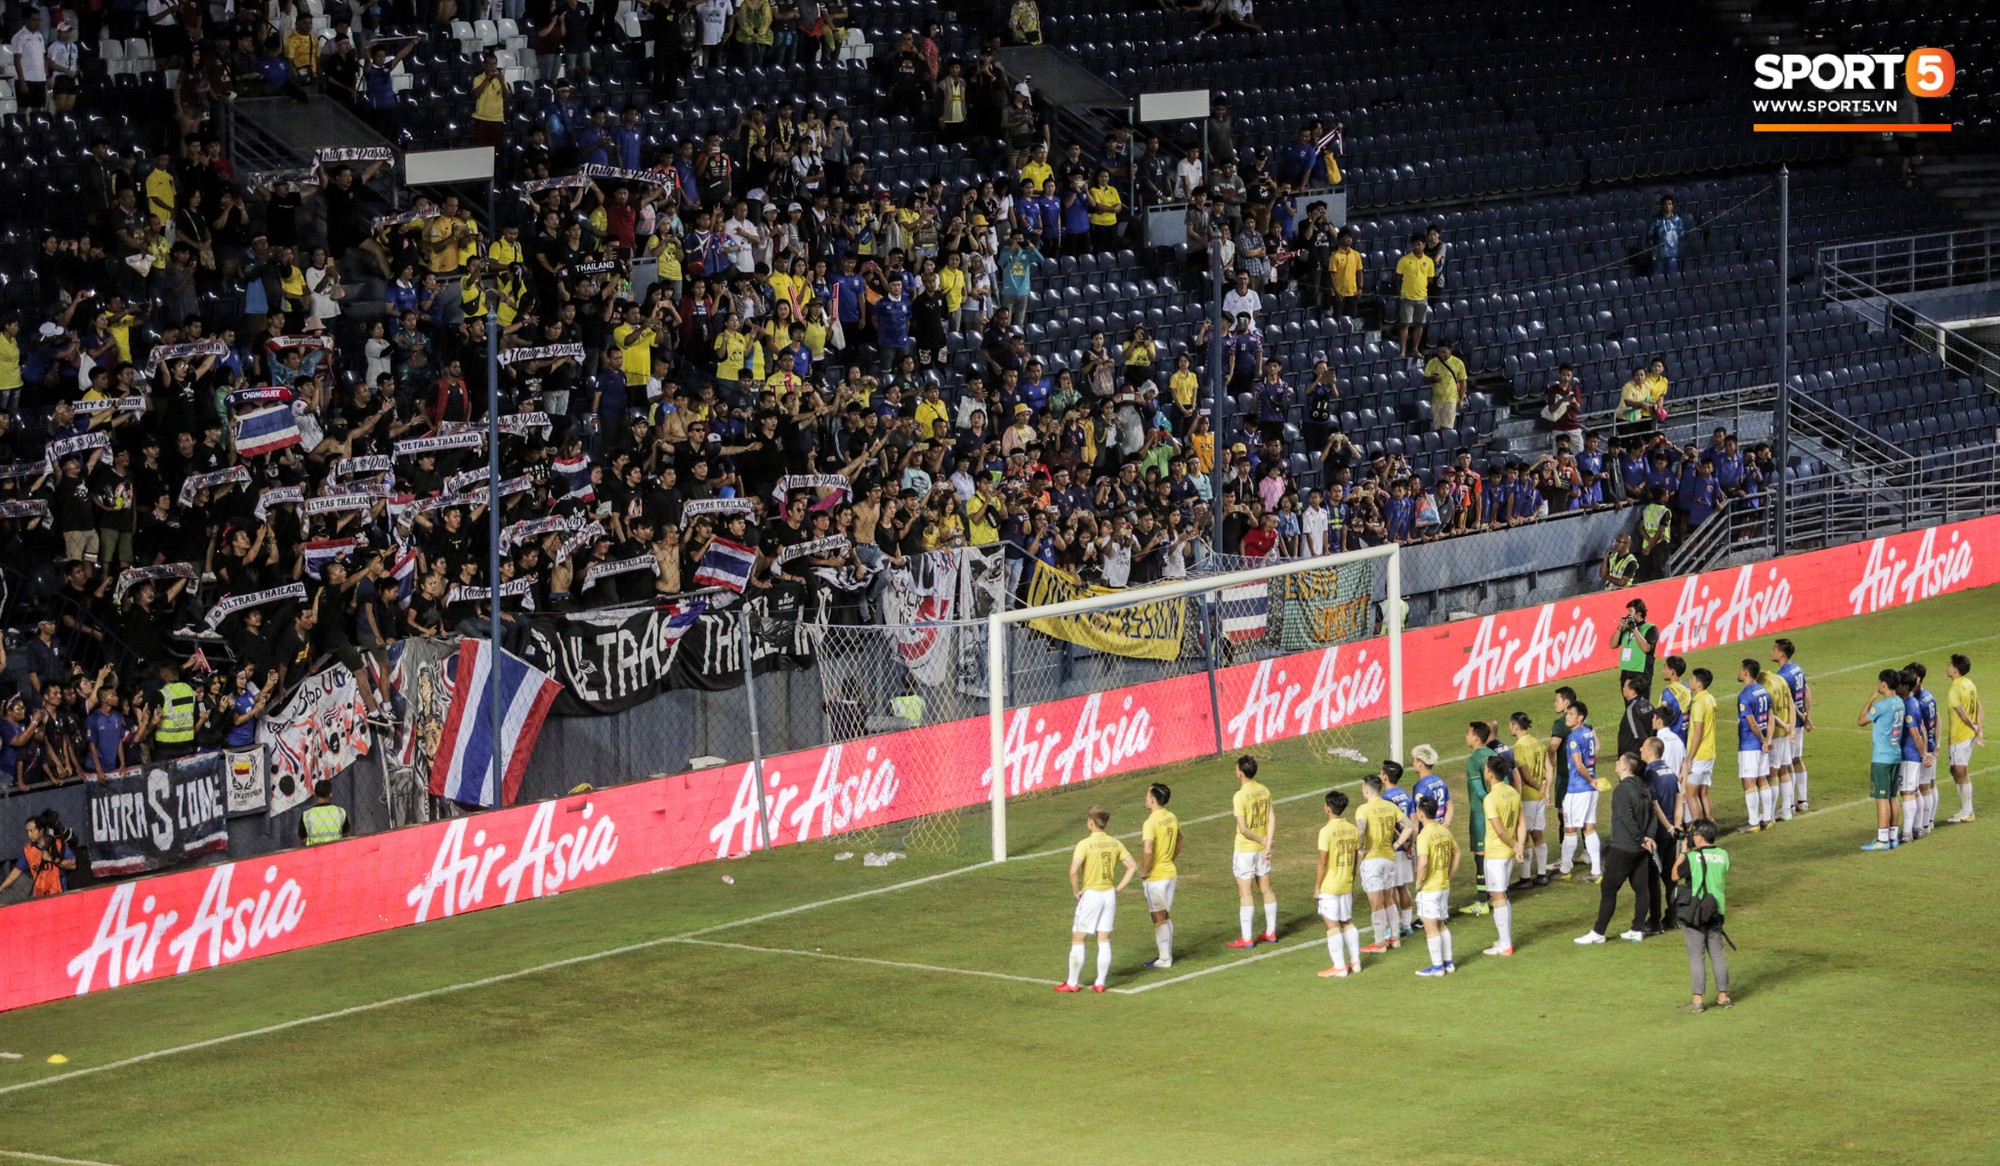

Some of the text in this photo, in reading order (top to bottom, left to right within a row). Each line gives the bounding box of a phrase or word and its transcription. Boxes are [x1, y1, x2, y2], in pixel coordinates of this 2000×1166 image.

[574, 261, 615, 272] THAILAND
[74, 400, 95, 411] NITY
[106, 398, 141, 408] PSION
[402, 433, 479, 451] ULTRAS THAILAND
[337, 495, 371, 508] THAILAN
[686, 501, 715, 514] ULTRAS
[220, 583, 304, 612] ULTRAS THAILAND
[176, 776, 223, 829] ZONE
[1696, 853, 1725, 864] OFICIAL
[1101, 851, 1112, 880] 3
